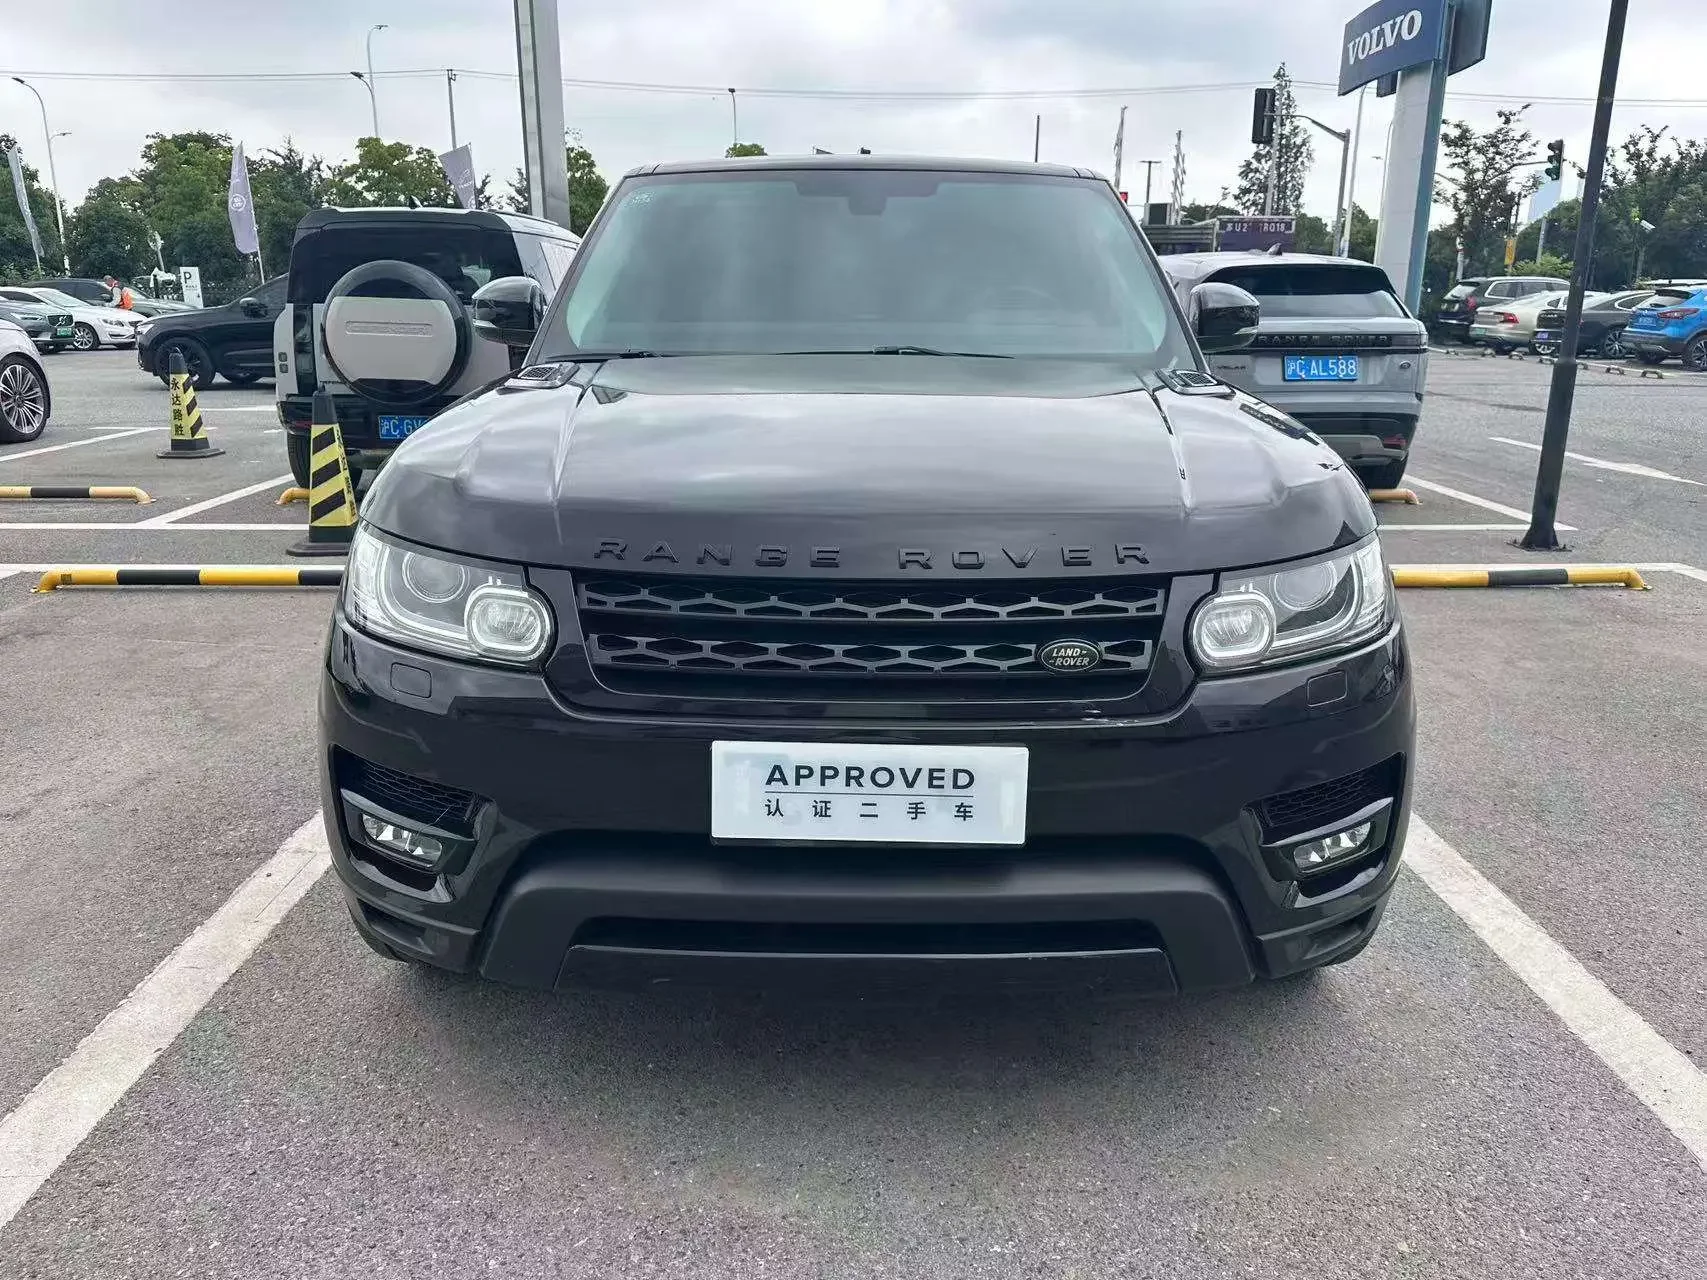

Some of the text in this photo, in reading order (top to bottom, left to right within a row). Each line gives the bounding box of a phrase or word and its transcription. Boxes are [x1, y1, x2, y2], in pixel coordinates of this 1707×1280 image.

[1347, 9, 1422, 65] VOLVO
[183, 271, 192, 284] P
[593, 537, 1150, 570] RANGE ROVER
[764, 763, 976, 791] APPROVED
[764, 799, 974, 822] 认证二手车
